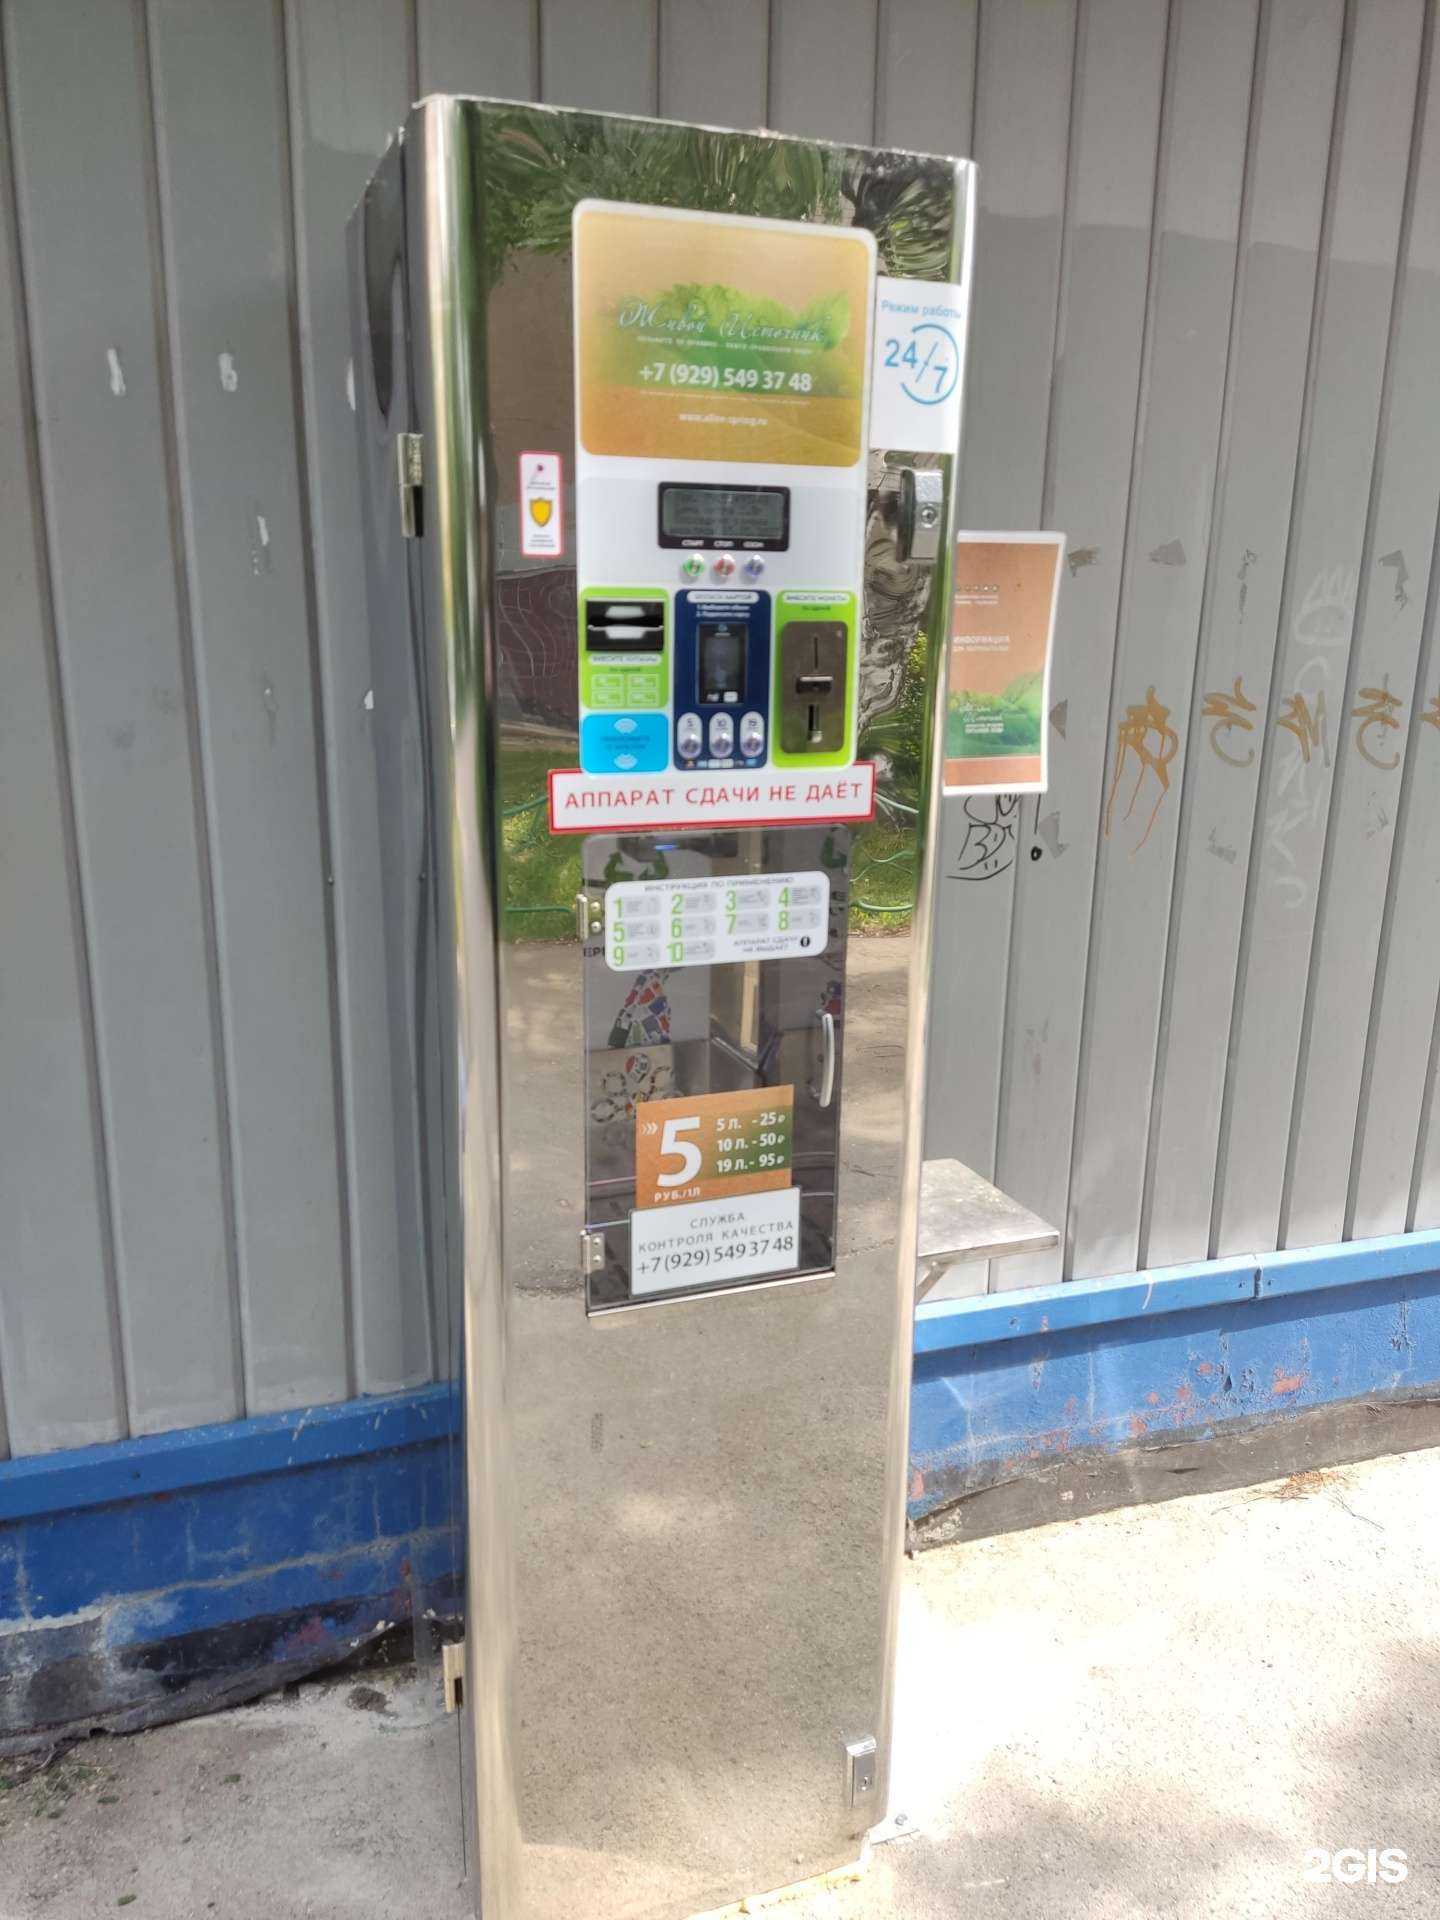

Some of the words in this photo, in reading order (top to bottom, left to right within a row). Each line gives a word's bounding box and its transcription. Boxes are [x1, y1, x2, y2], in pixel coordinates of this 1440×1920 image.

[881, 299, 919, 314] Режим
[719, 311, 832, 342] Источник
[639, 362, 666, 382] +7
[669, 363, 719, 388] (929)
[723, 367, 759, 388] 549
[762, 370, 785, 389] 37
[788, 372, 813, 392] 48
[884, 339, 948, 394] 24/7
[564, 788, 675, 810] АППАРАТ
[685, 786, 760, 807] СДАЧИ
[769, 784, 797, 802] НЕ
[806, 780, 863, 803] ДАЁТ
[614, 896, 623, 918] 1
[671, 894, 683, 914] 2
[725, 890, 736, 911] 3
[778, 887, 789, 908] 4
[613, 921, 624, 942] 5
[672, 919, 682, 938] 6
[725, 914, 736, 936] 7
[778, 911, 789, 931] 8
[613, 946, 624, 966] 9
[667, 942, 683, 963] 10
[716, 1118, 725, 1132] 5
[728, 1117, 742, 1130] Л.
[657, 1116, 702, 1187] 5
[717, 1138, 732, 1152] 10
[735, 1137, 749, 1150] Л.
[716, 1159, 732, 1173] 19
[690, 1212, 745, 1229] СЛУЖБА
[638, 1232, 713, 1253] КОНТРОЛЯ
[722, 1220, 793, 1240] КАЧЕСТВА
[637, 1256, 661, 1275] +7
[664, 1249, 710, 1272] (929)
[714, 1244, 746, 1263] 549
[749, 1240, 769, 1257] 37
[772, 1236, 793, 1251] 48
